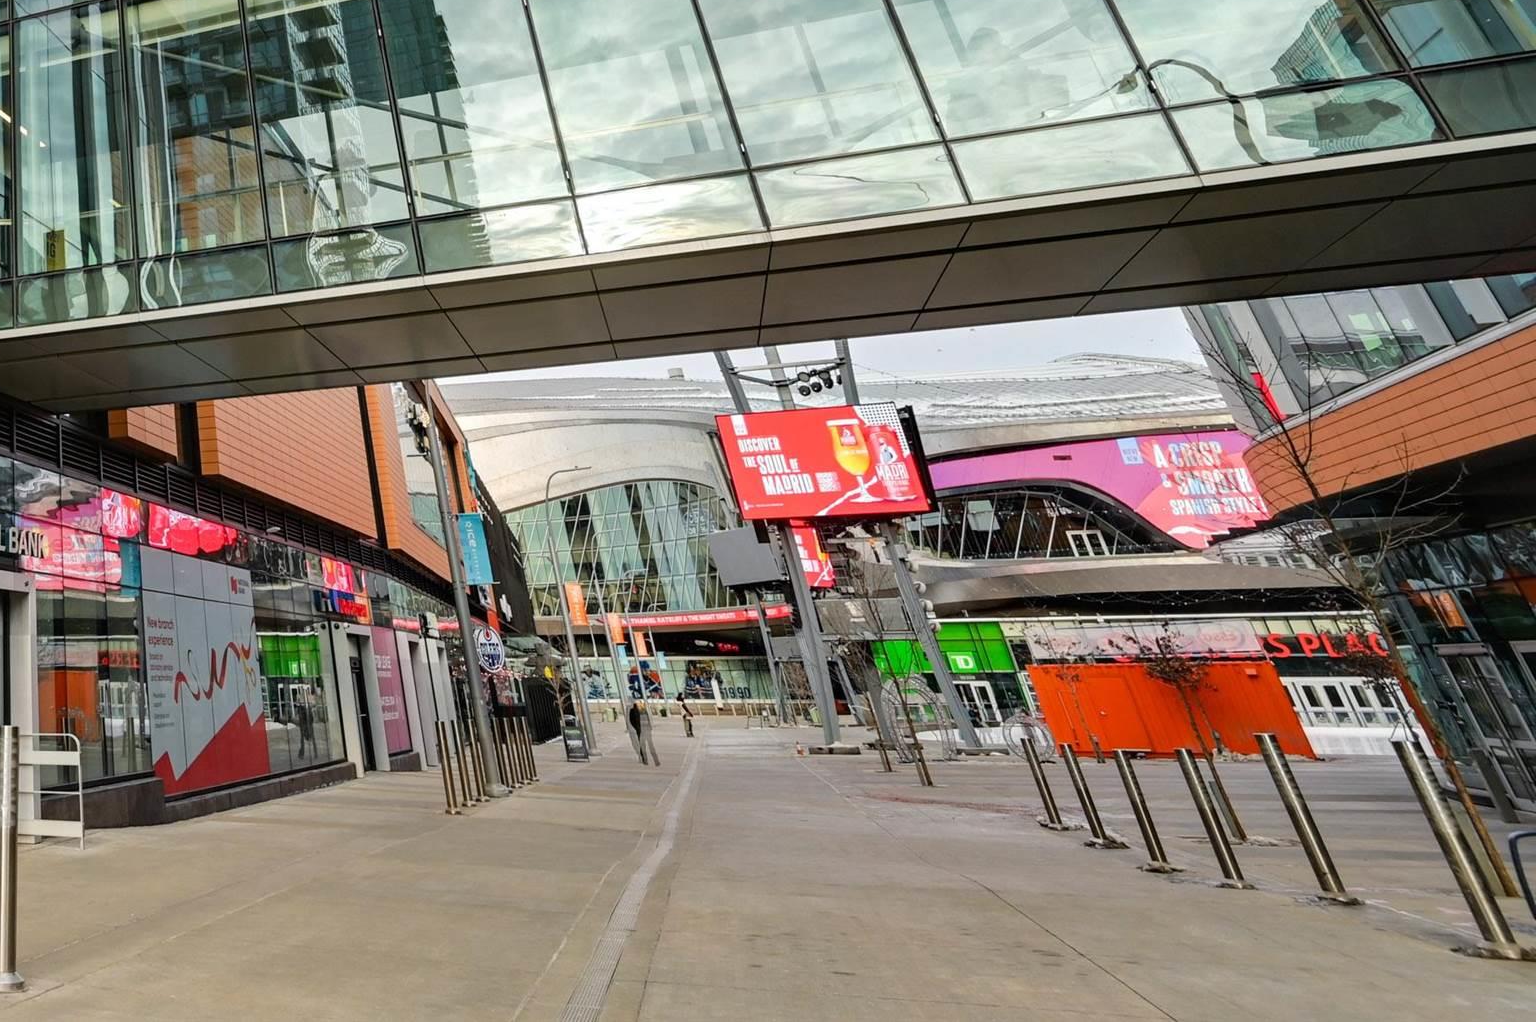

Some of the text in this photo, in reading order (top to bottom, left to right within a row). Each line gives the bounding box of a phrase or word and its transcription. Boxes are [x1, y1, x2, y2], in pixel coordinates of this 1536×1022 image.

[737, 436, 781, 453] DISCOVER
[1152, 441, 1222, 468] A CRISP
[742, 453, 800, 475] THE SOUL OF
[762, 472, 815, 496] MADRID
[1174, 468, 1252, 496] SMOOTH
[1169, 499, 1221, 516] SPANISH
[1222, 497, 1259, 514] STYLE
[9, 527, 49, 559] BANK
[1295, 632, 1390, 658] PLAC
[950, 655, 975, 669] TD
